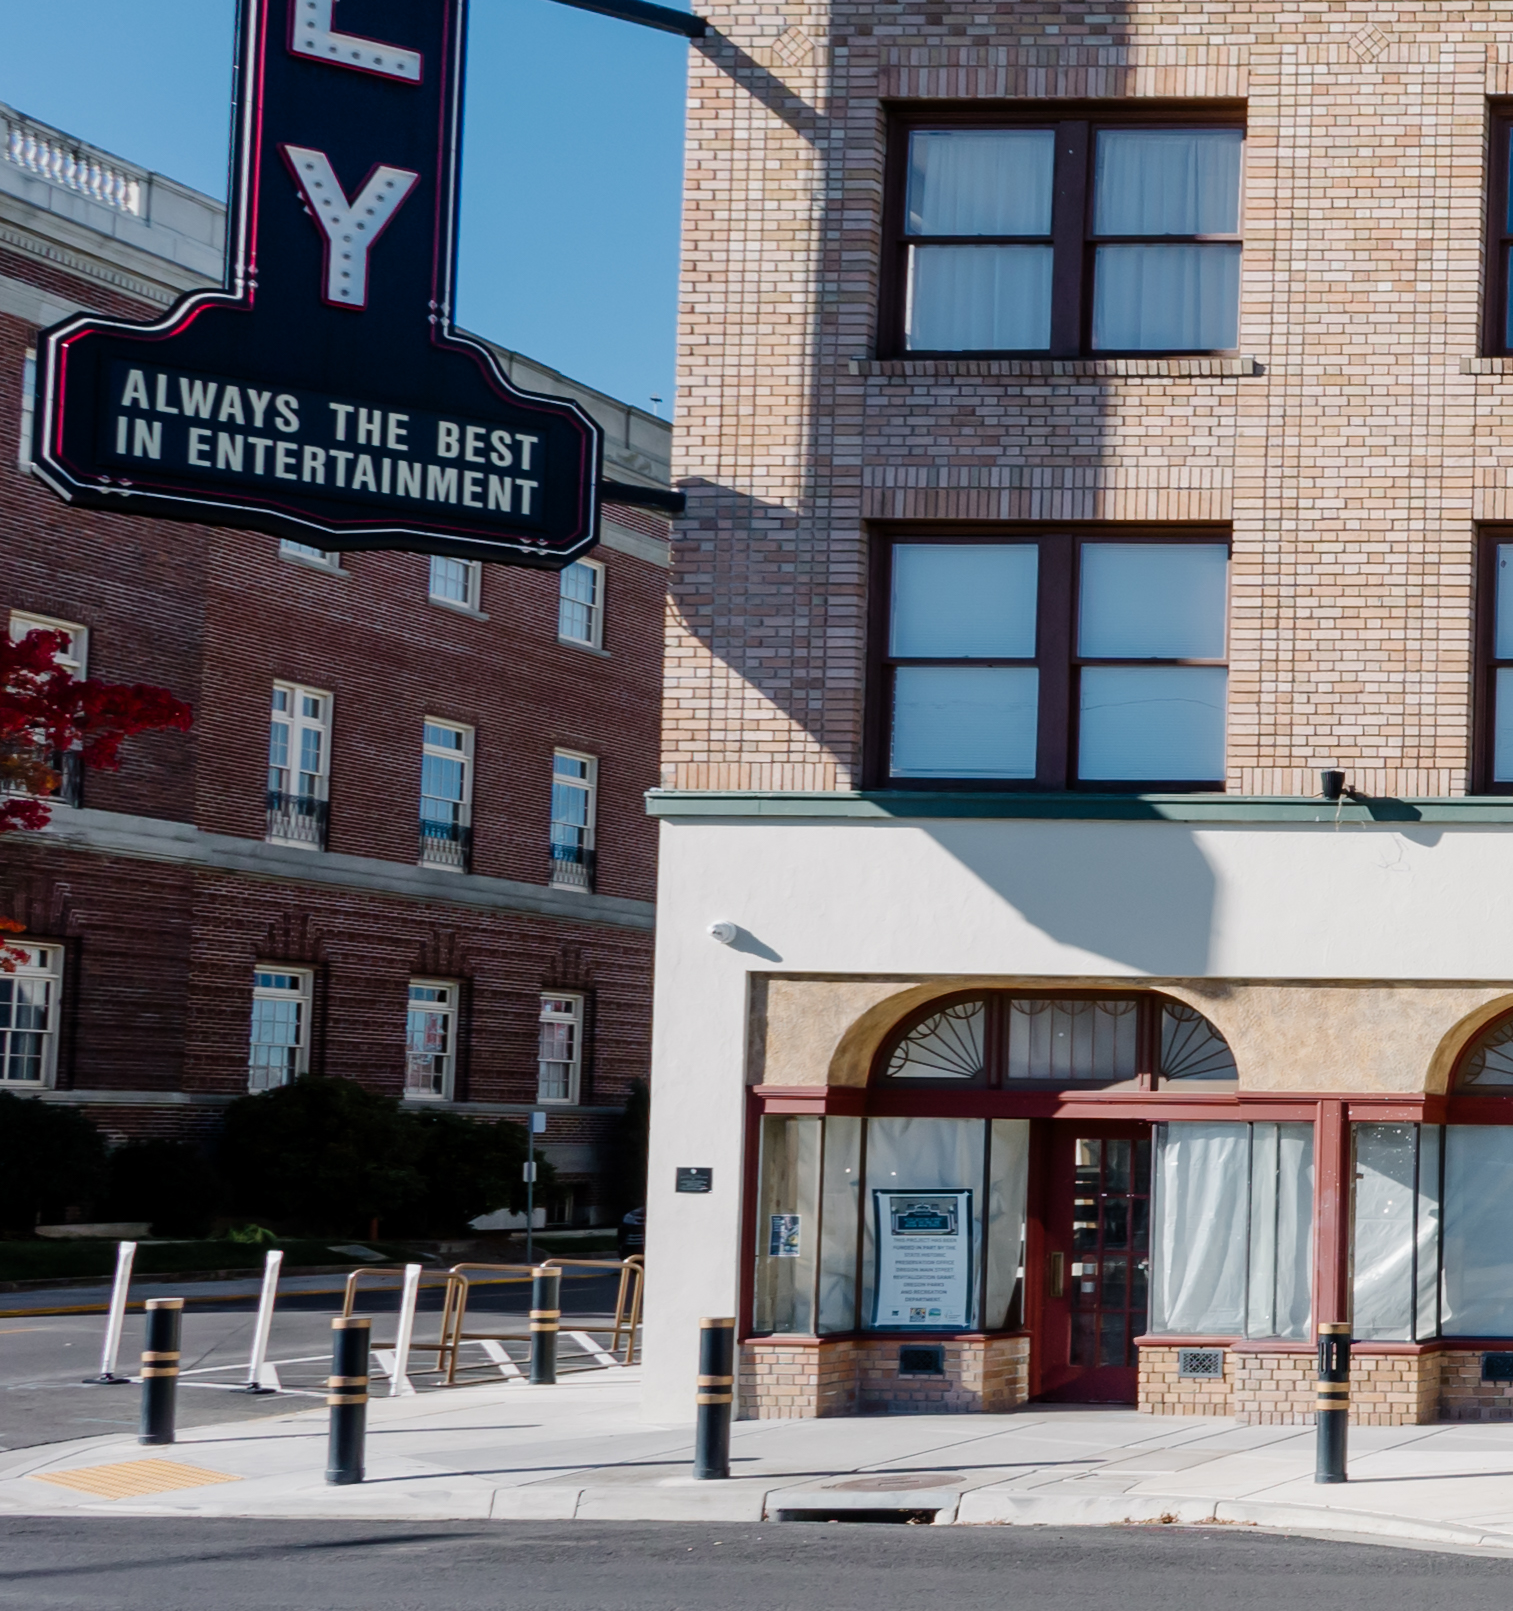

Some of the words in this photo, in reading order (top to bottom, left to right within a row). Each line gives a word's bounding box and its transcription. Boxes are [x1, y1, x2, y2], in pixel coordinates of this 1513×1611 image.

[117, 416, 162, 459] IN
[188, 427, 538, 515] ENTERTAINMENT
[121, 369, 299, 433] ALWAYS
[329, 402, 409, 451] THE
[437, 421, 538, 470] BEST
